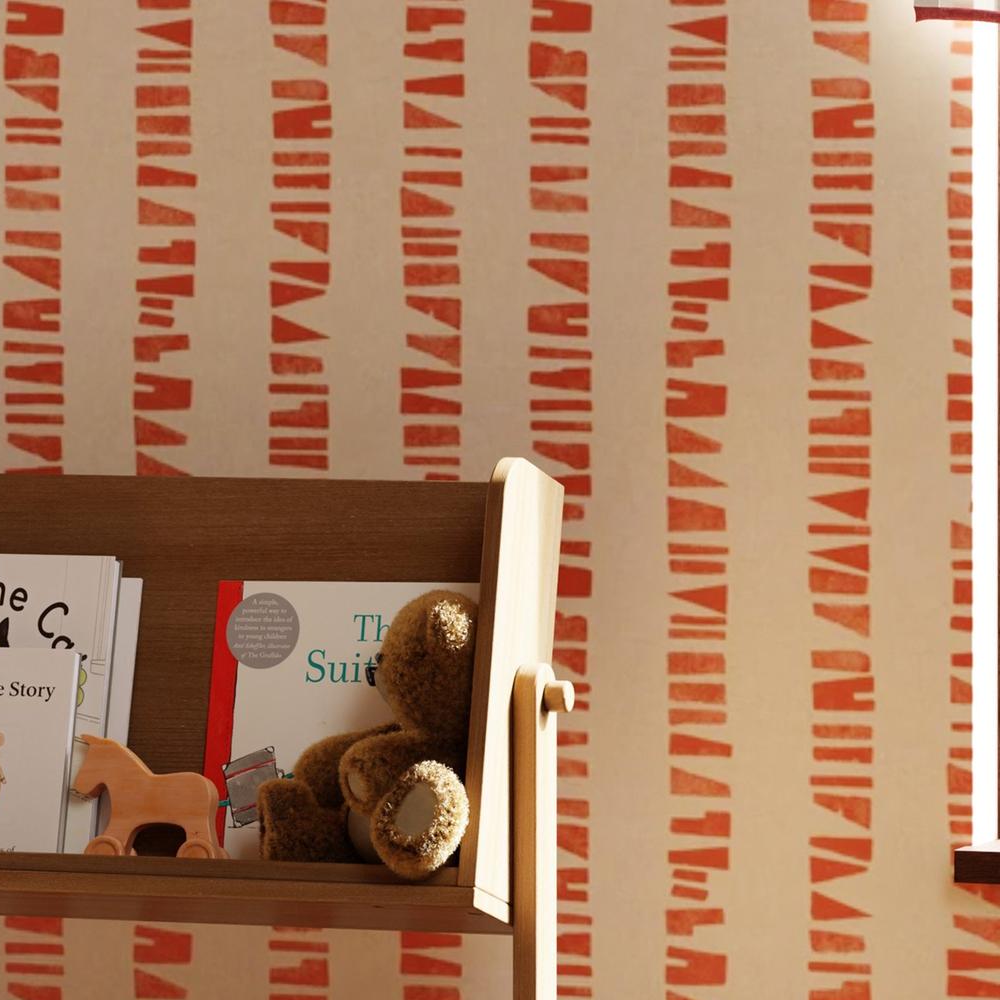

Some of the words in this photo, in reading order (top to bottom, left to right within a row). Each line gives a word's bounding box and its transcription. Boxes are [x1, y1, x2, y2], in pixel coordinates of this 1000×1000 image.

[37, 601, 88, 662] Ca
[353, 614, 390, 642] Th
[305, 648, 378, 684] Suit
[8, 681, 56, 702] Story
